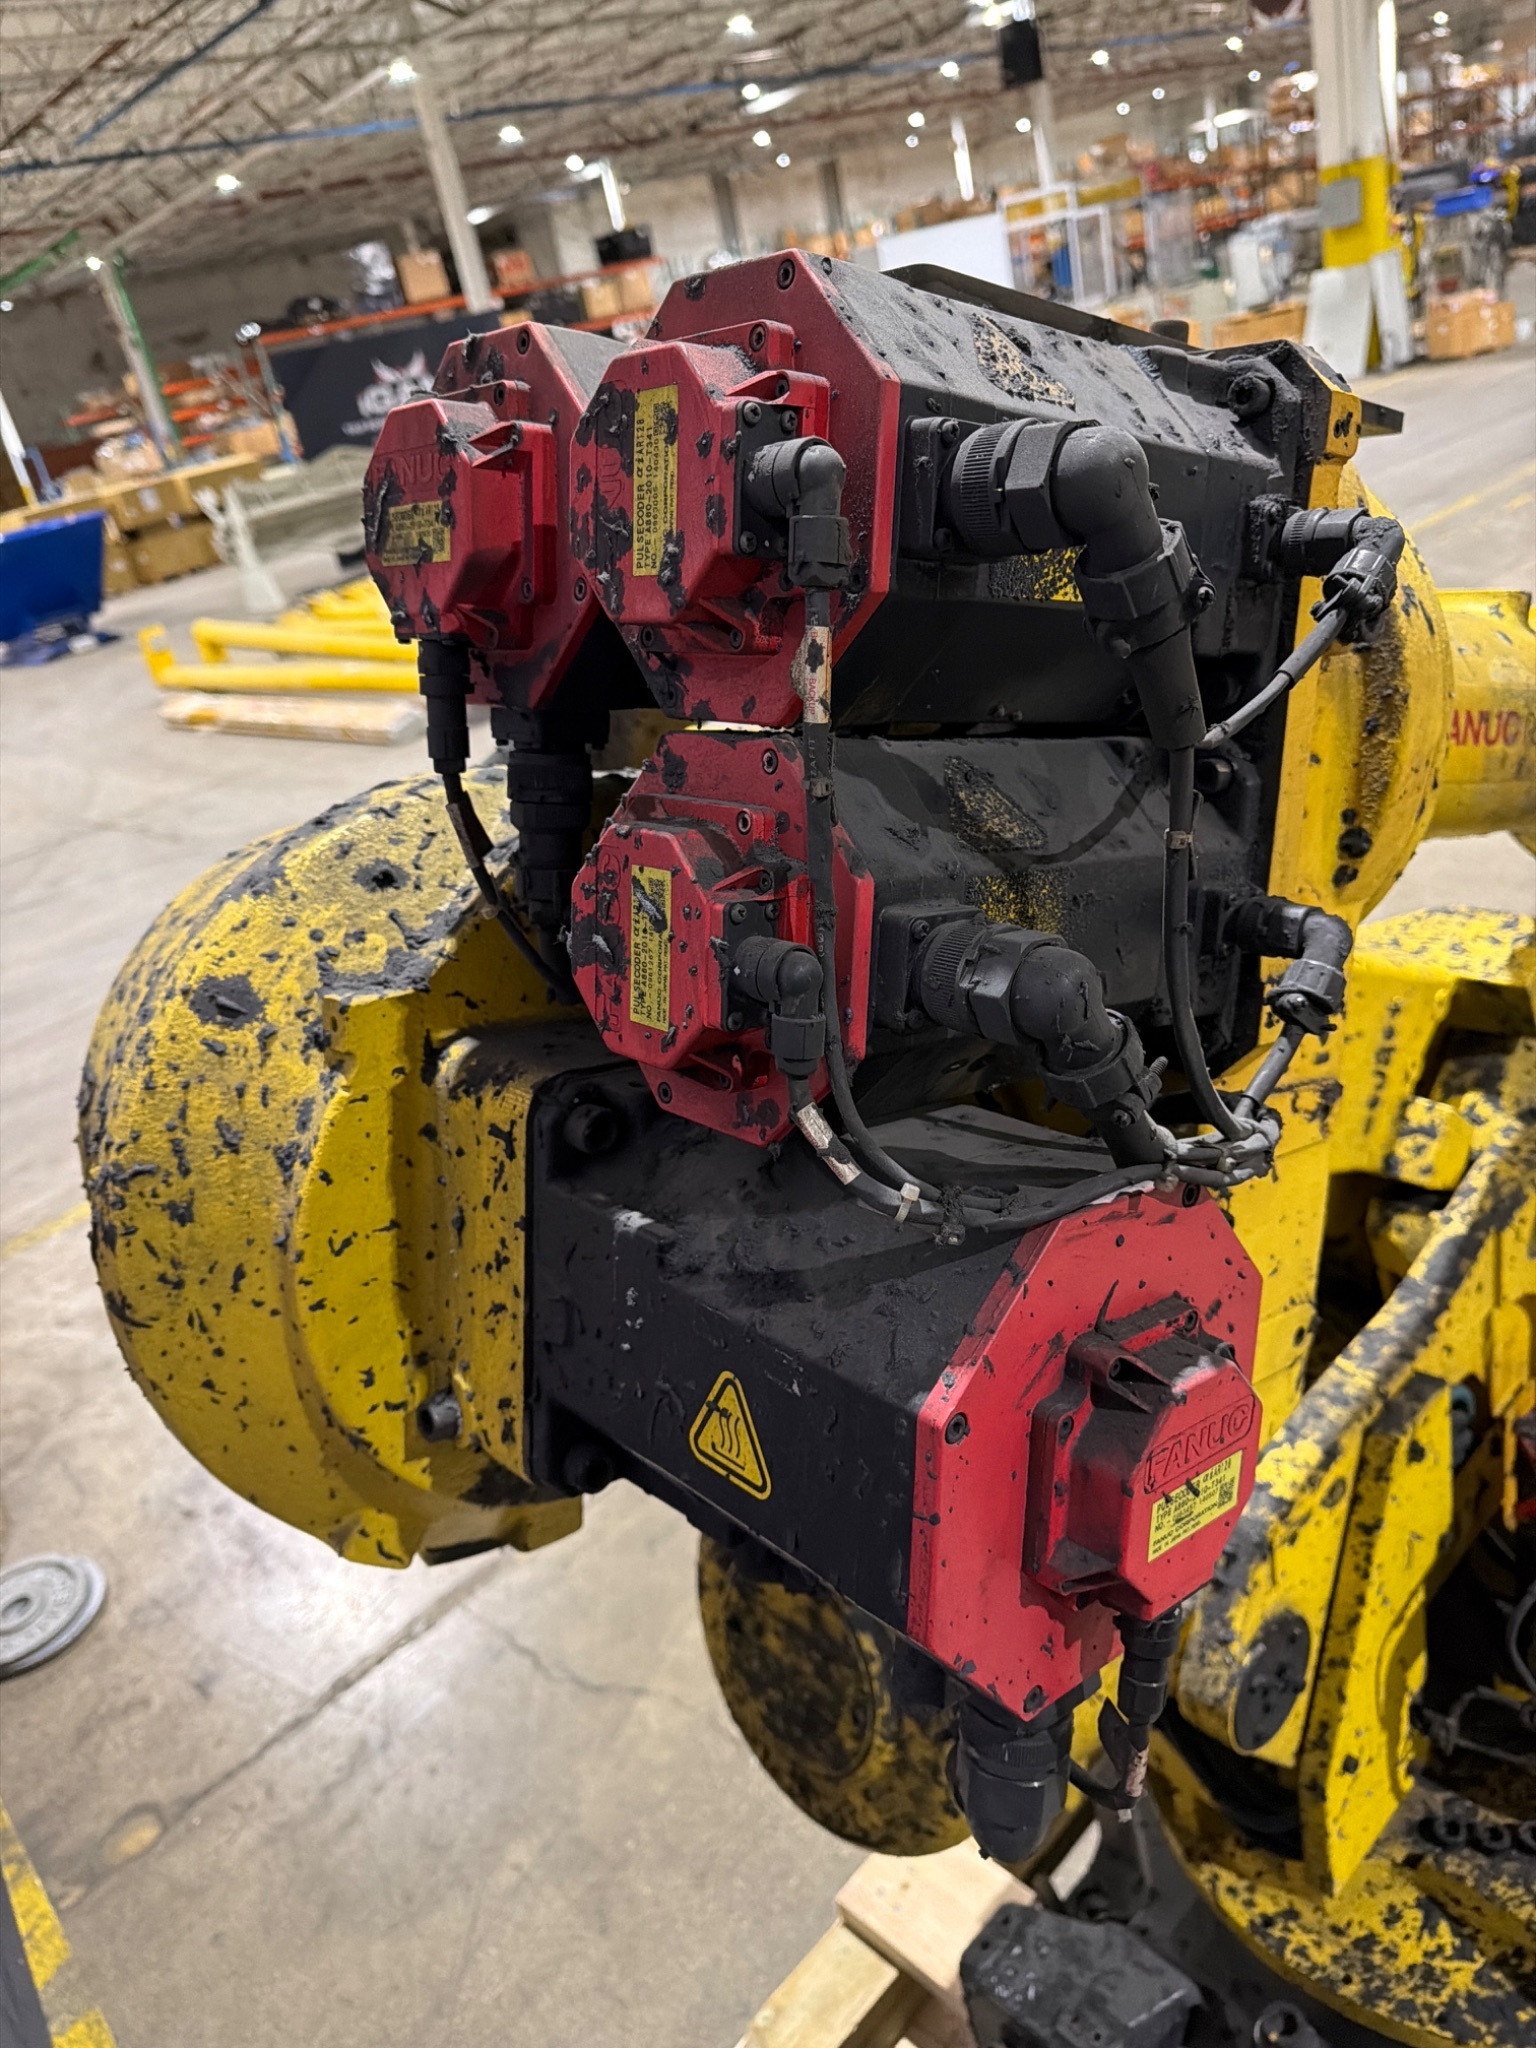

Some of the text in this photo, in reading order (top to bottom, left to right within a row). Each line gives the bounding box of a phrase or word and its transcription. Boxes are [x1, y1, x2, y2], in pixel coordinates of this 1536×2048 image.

[636, 484, 645, 569] PULSECODER
[807, 678, 816, 714] BACKUP
[1450, 709, 1522, 747] ANUC
[632, 942, 641, 1014] PULSECODER
[1148, 1405, 1249, 1489] FANUC
[1153, 1501, 1218, 1547] FANUC CORPORATION
[1156, 1508, 1172, 1523] TYPE
